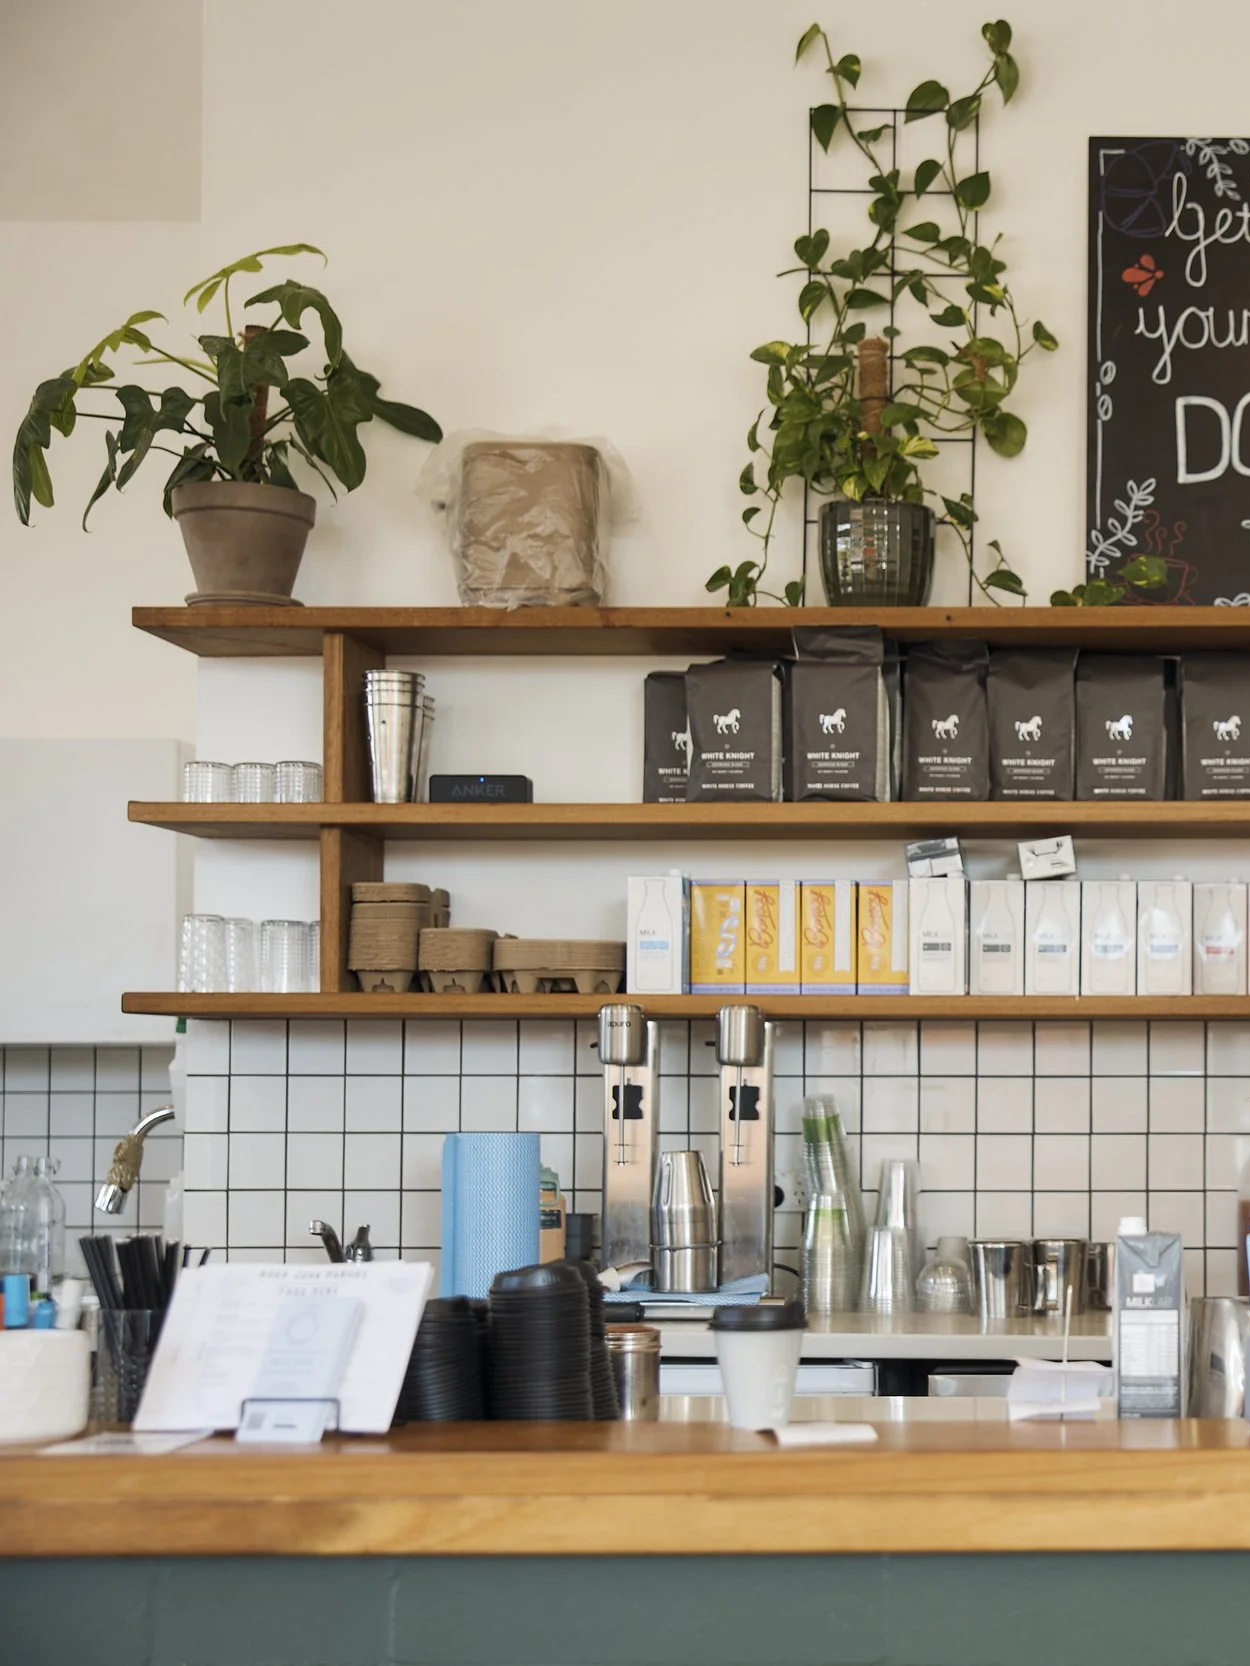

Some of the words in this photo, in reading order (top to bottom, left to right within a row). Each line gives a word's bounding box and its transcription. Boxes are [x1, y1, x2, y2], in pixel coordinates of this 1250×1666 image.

[701, 752, 723, 760] WHITE
[725, 752, 755, 760] KNIGHT
[807, 752, 829, 760] WHITE
[831, 752, 860, 760] KNIGHT
[658, 767, 681, 775] WHITE
[452, 784, 506, 798] ANKER
